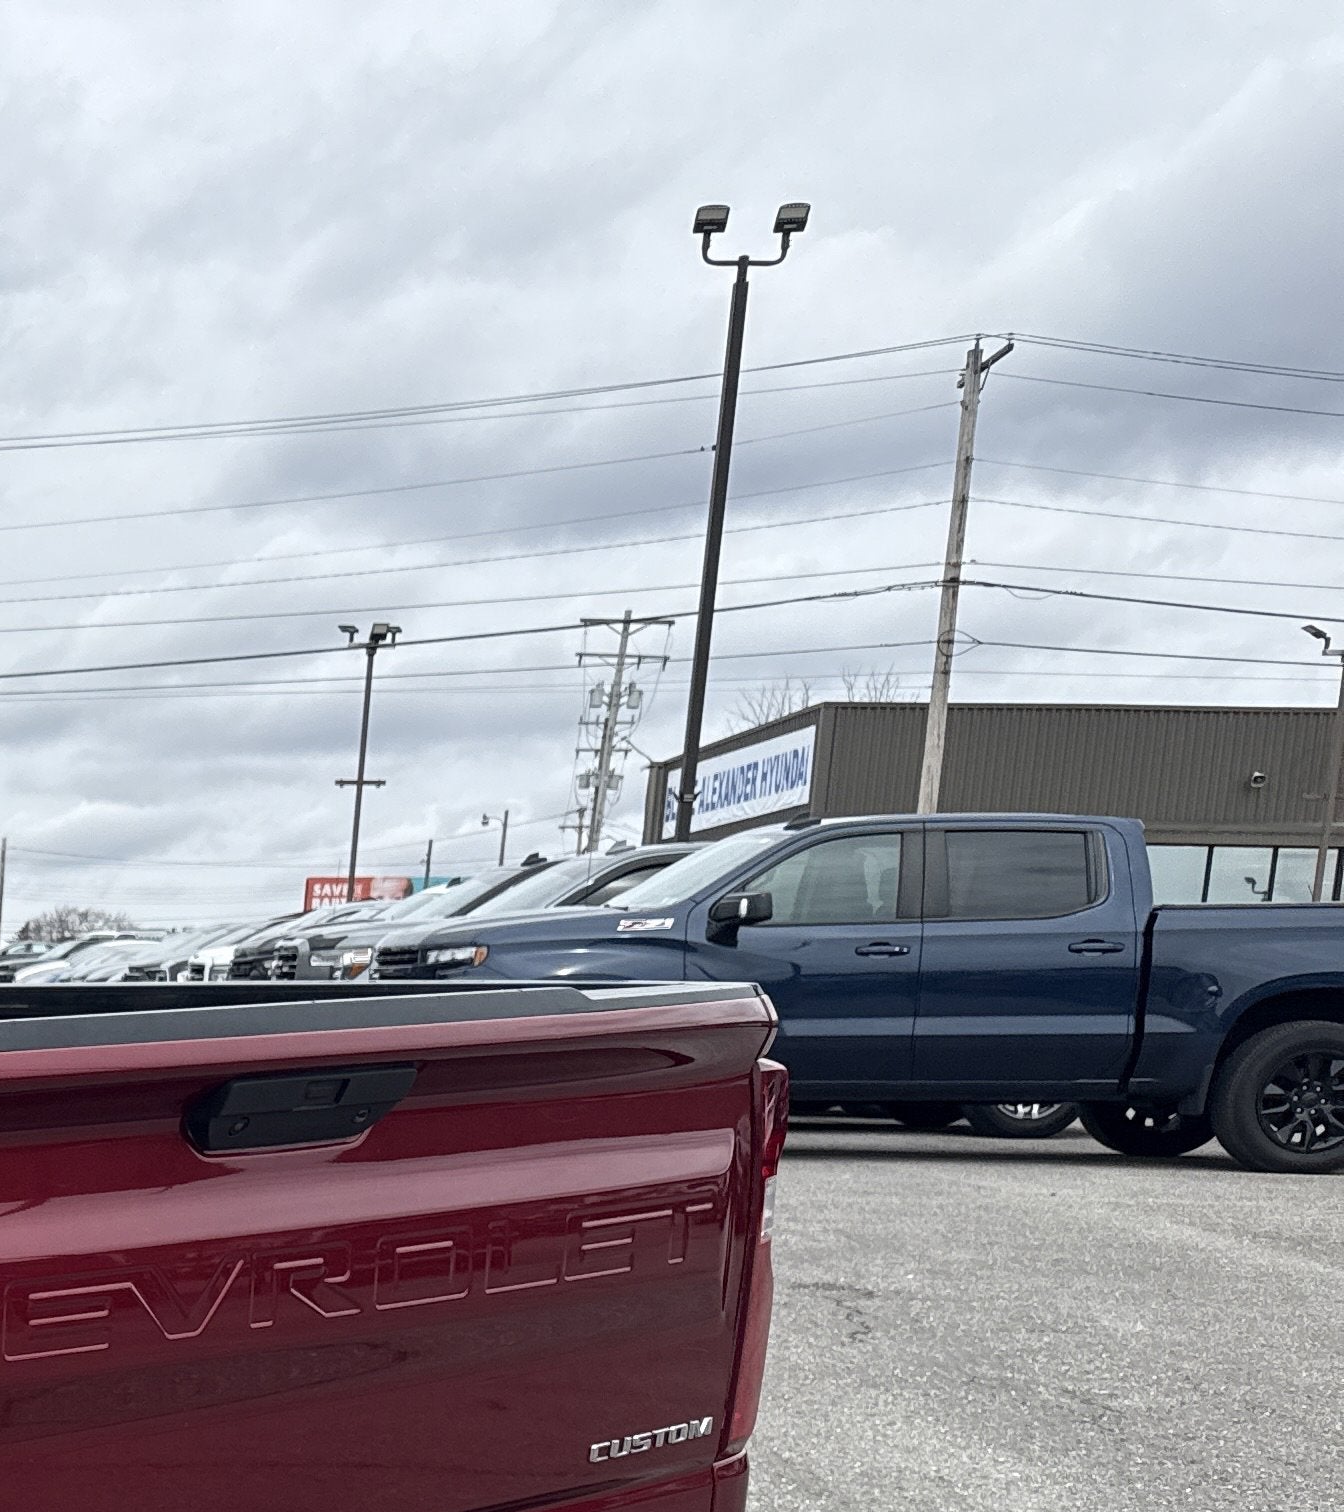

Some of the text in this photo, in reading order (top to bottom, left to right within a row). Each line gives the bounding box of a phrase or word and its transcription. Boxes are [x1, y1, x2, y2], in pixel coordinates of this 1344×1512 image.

[698, 760, 759, 815] ALEXANDER
[759, 744, 811, 799] HYUNDAI
[589, 1416, 713, 1463] CUSTOM
